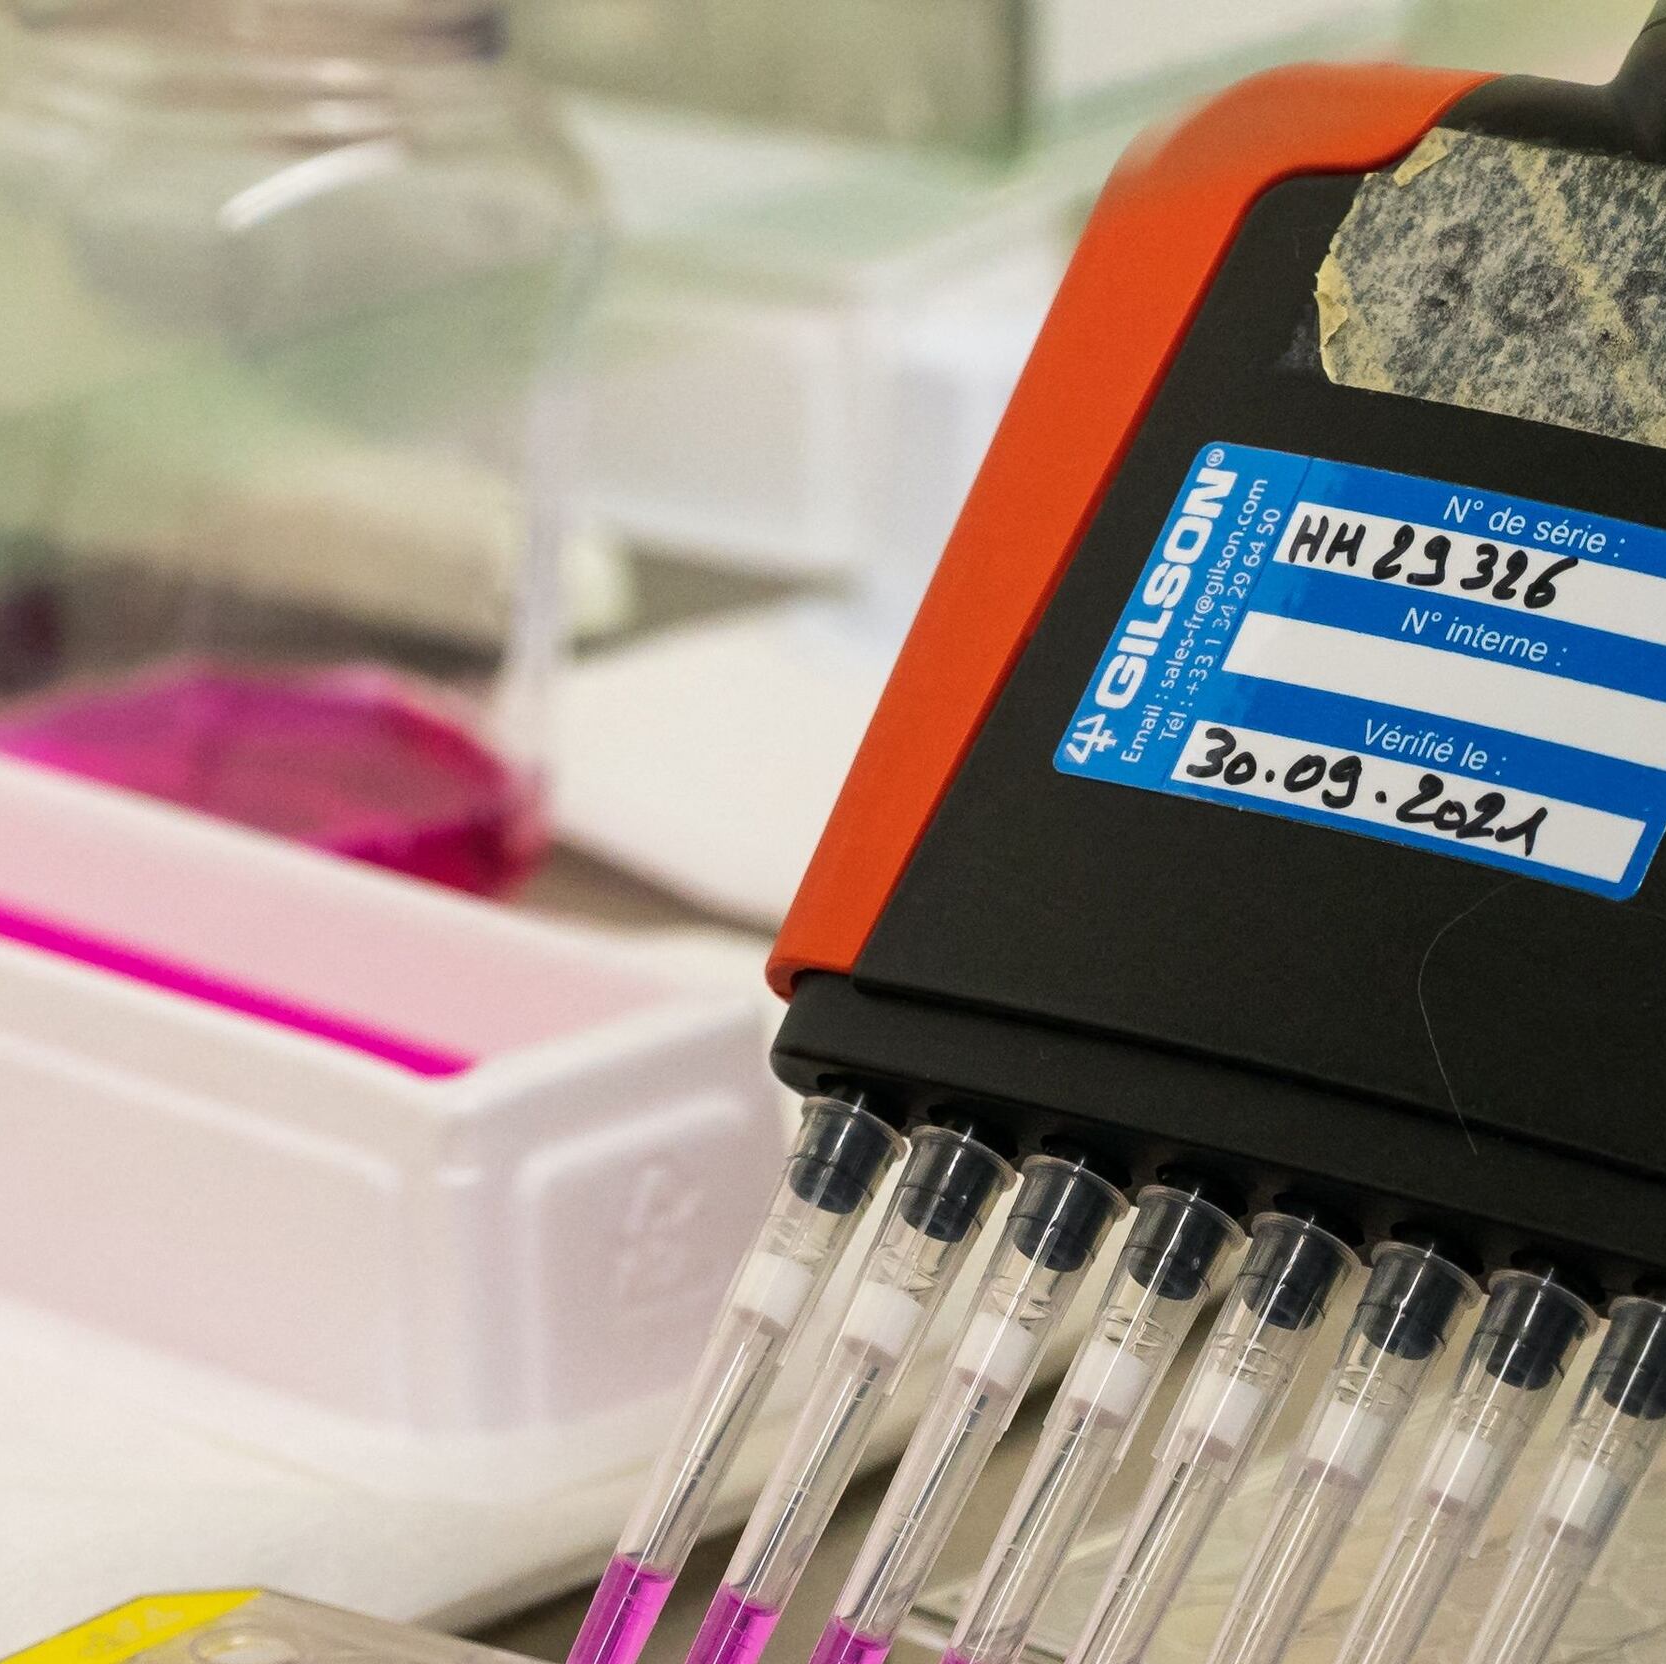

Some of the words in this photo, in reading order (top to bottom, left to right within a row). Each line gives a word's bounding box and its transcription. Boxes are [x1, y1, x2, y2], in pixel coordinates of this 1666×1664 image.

[1256, 509, 1281, 536] 50
[1488, 506, 1526, 536] de
[1532, 519, 1607, 553] série
[1243, 540, 1266, 567] 64
[1227, 572, 1251, 599] 29
[1120, 702, 1164, 763] Email
[1160, 479, 1268, 689] sales-fr@gilson.com
[1212, 604, 1237, 631] 34
[1205, 637, 1221, 645] 1
[1445, 616, 1548, 662] interne
[1186, 655, 1214, 696] +33
[1158, 711, 1188, 741] Tél
[1364, 718, 1454, 762] Vérifié
[1459, 742, 1489, 770] le
[1186, 727, 1548, 856] 30.09.2021
